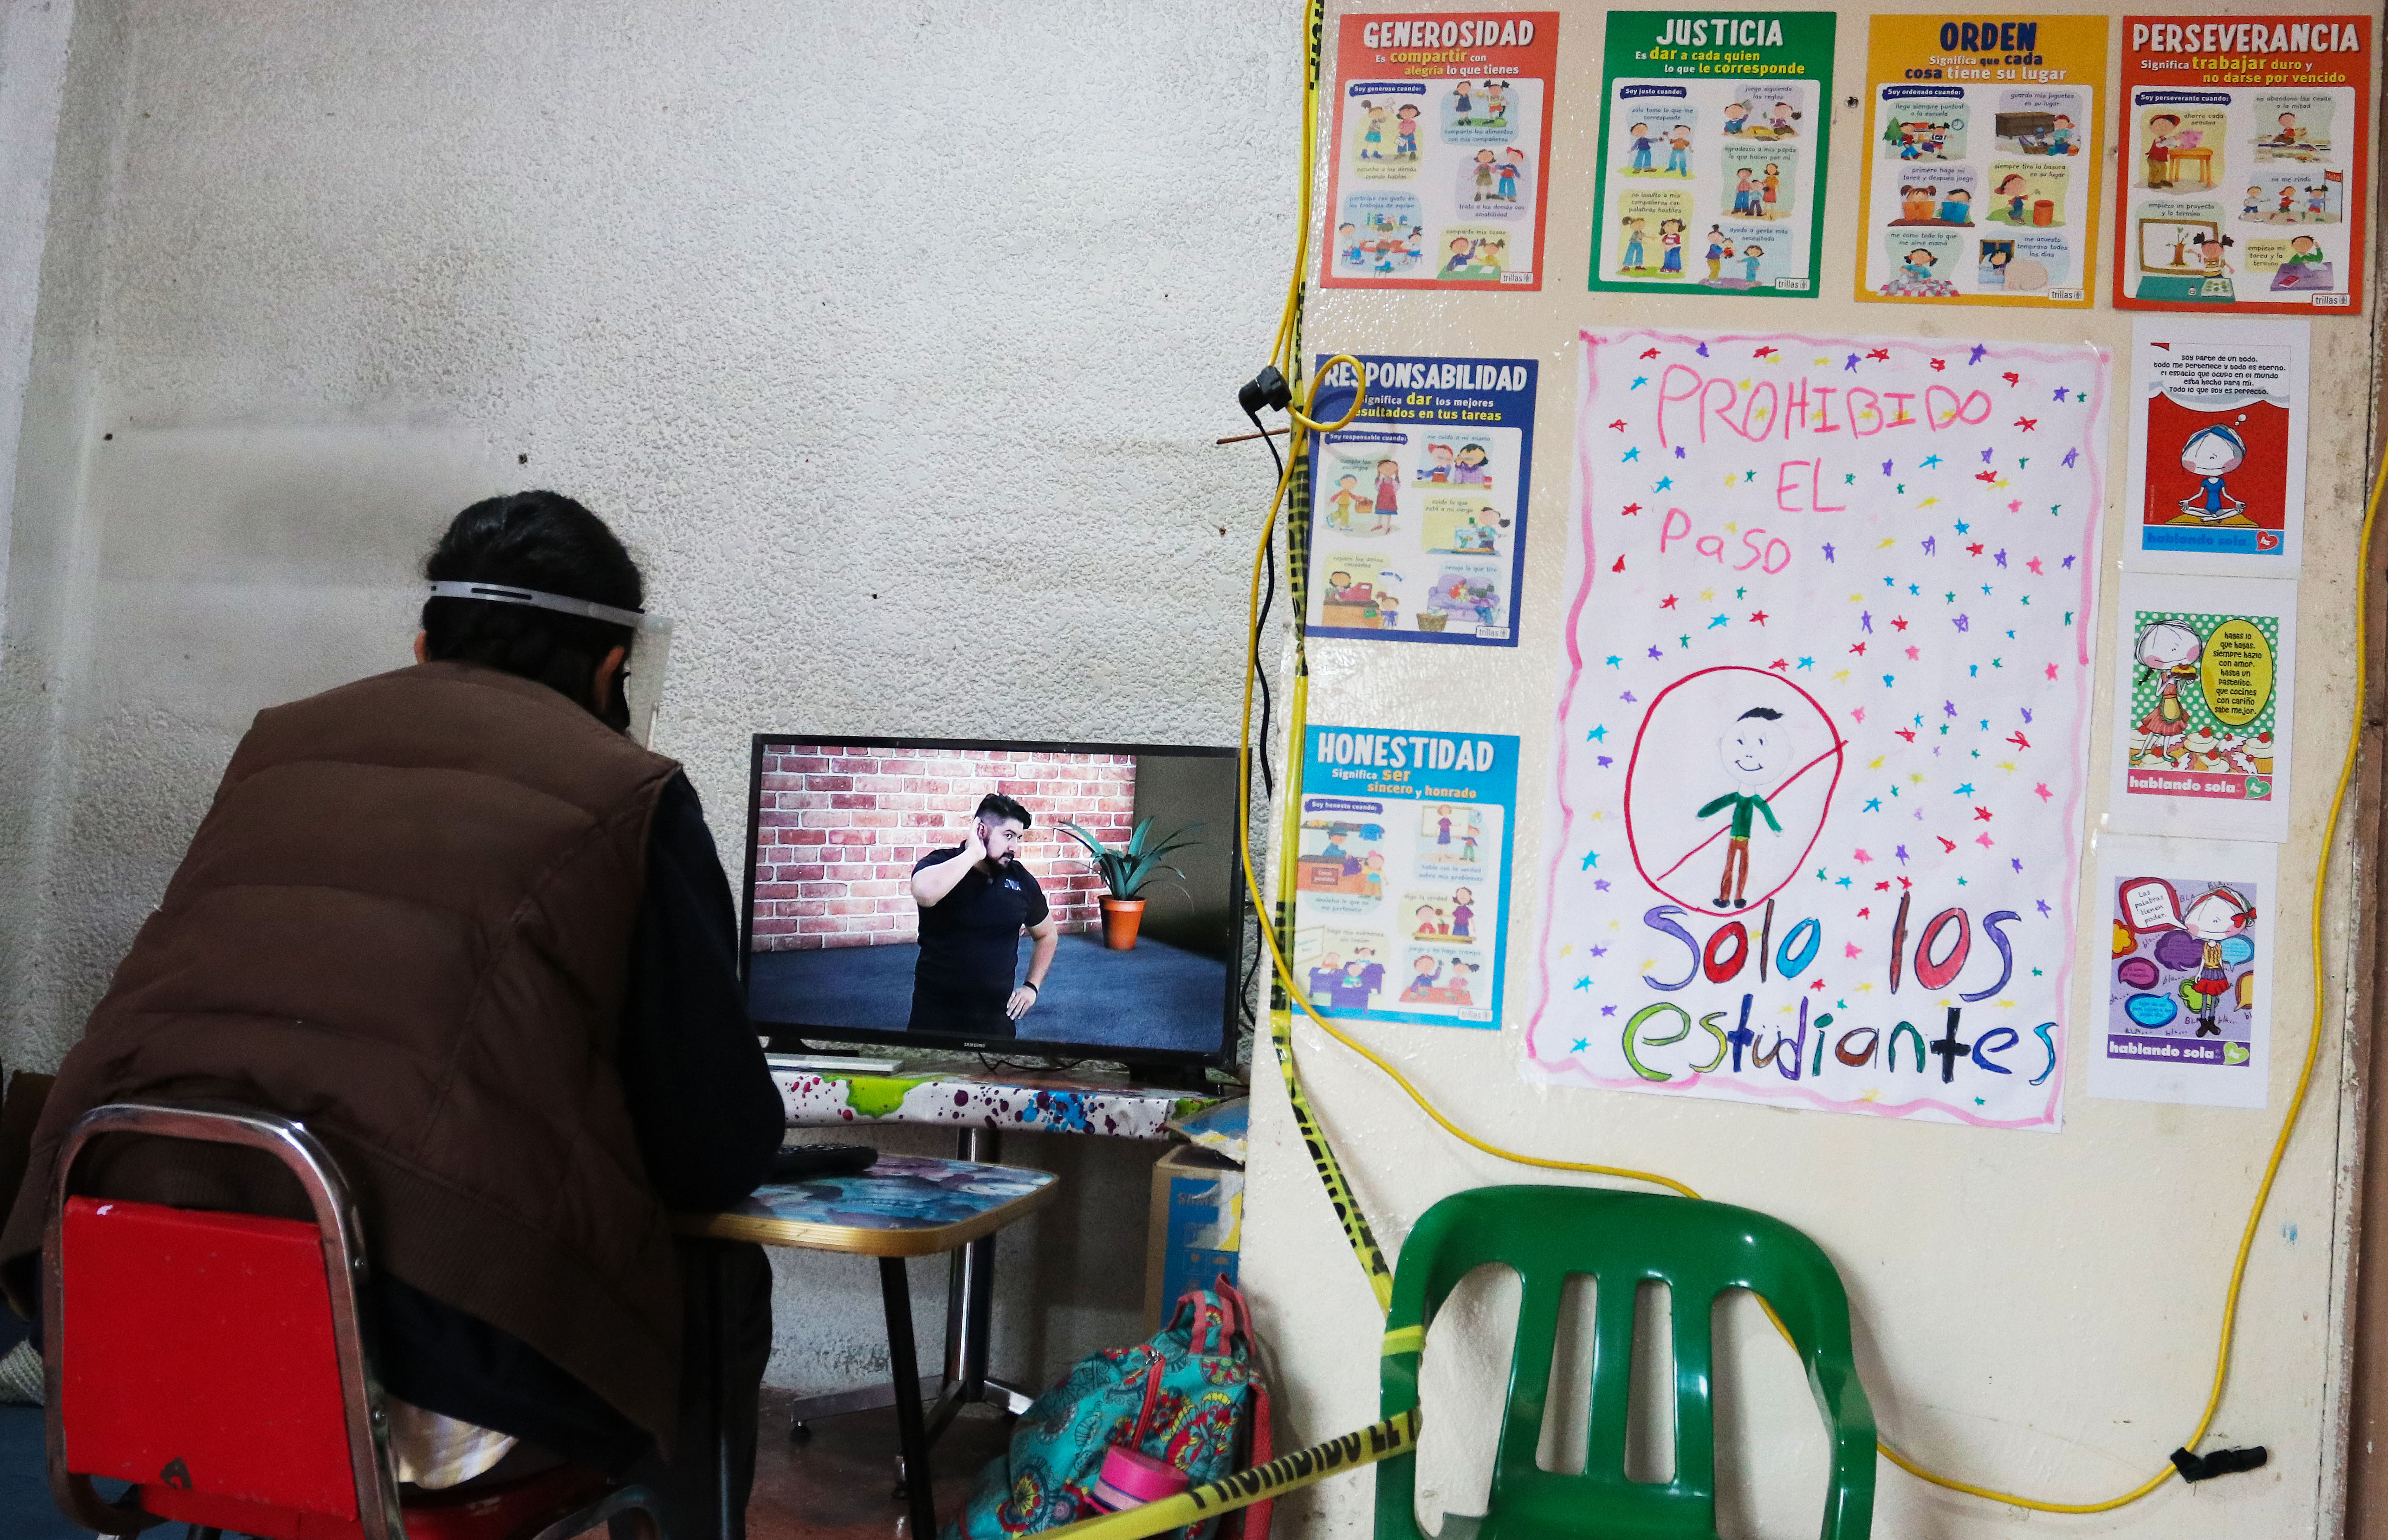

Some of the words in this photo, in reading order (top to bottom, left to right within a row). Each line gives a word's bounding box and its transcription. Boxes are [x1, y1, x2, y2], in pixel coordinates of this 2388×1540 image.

[1364, 19, 1536, 48] GENEROSIDAD
[1656, 19, 1783, 46] JUSTICIA
[1940, 22, 2038, 52] ORDEN
[2133, 23, 2359, 53] PERSEVERANCIA
[1390, 49, 1467, 65] compartir
[1649, 46, 1677, 60] dar
[1692, 50, 1720, 60] cada
[1724, 51, 1760, 63] quien
[1929, 56, 1977, 66] Significa
[1980, 58, 1999, 67] que
[2004, 52, 2043, 65] cada
[1446, 66, 1457, 74] lo
[1460, 67, 1481, 77] que
[1484, 65, 1519, 74] tienes
[1677, 66, 1695, 75] que
[1699, 64, 1710, 73] le
[1714, 62, 1805, 76] corresponde
[2141, 60, 2190, 71] Significa
[2192, 55, 2267, 73] trabajar
[2271, 61, 2302, 70] duro
[2305, 62, 2313, 71] y
[1905, 68, 1942, 79] cosa
[1947, 67, 1990, 79] tiene
[1996, 68, 2015, 79] su
[2022, 66, 2067, 83] lugar
[2203, 74, 2220, 83] no
[2223, 73, 2262, 83] darse
[2265, 74, 2289, 85] por
[2292, 73, 2346, 83] vencido
[1779, 280, 1798, 288] trillas
[2052, 291, 2072, 299] trillas
[2316, 295, 2338, 304] trillas
[1363, 395, 1402, 404] ignifica
[1406, 392, 1432, 406] dar
[1435, 397, 1451, 406] los
[1453, 398, 1494, 408] mejores
[1657, 363, 1993, 448] PROHIBIDO
[1356, 406, 1415, 419] esultados
[1419, 410, 1433, 418] en
[1438, 410, 1458, 419] tus
[1461, 411, 1502, 421] tareas
[1776, 456, 1847, 512] EL
[2148, 533, 2213, 545] hablando
[2218, 535, 2246, 546] sola
[1479, 628, 1499, 637] trillas
[2213, 650, 2242, 659] siempre
[2221, 669, 2240, 677] hasta
[2232, 697, 2255, 705] cariño
[1318, 732, 1494, 772] HONESTIDAD
[1332, 768, 1377, 780] Significa
[1382, 770, 1411, 782] ser
[1367, 782, 1413, 794] sincero
[1415, 790, 1421, 799] y
[1425, 785, 1477, 799] honrado
[2130, 776, 2201, 791] hablando
[2205, 781, 2236, 793] sola
[2141, 905, 2163, 915] tienen
[1643, 899, 1821, 992] Solo
[1889, 890, 2022, 1002] los
[2109, 1042, 2180, 1057] hablando
[2183, 1046, 2214, 1059] sola
